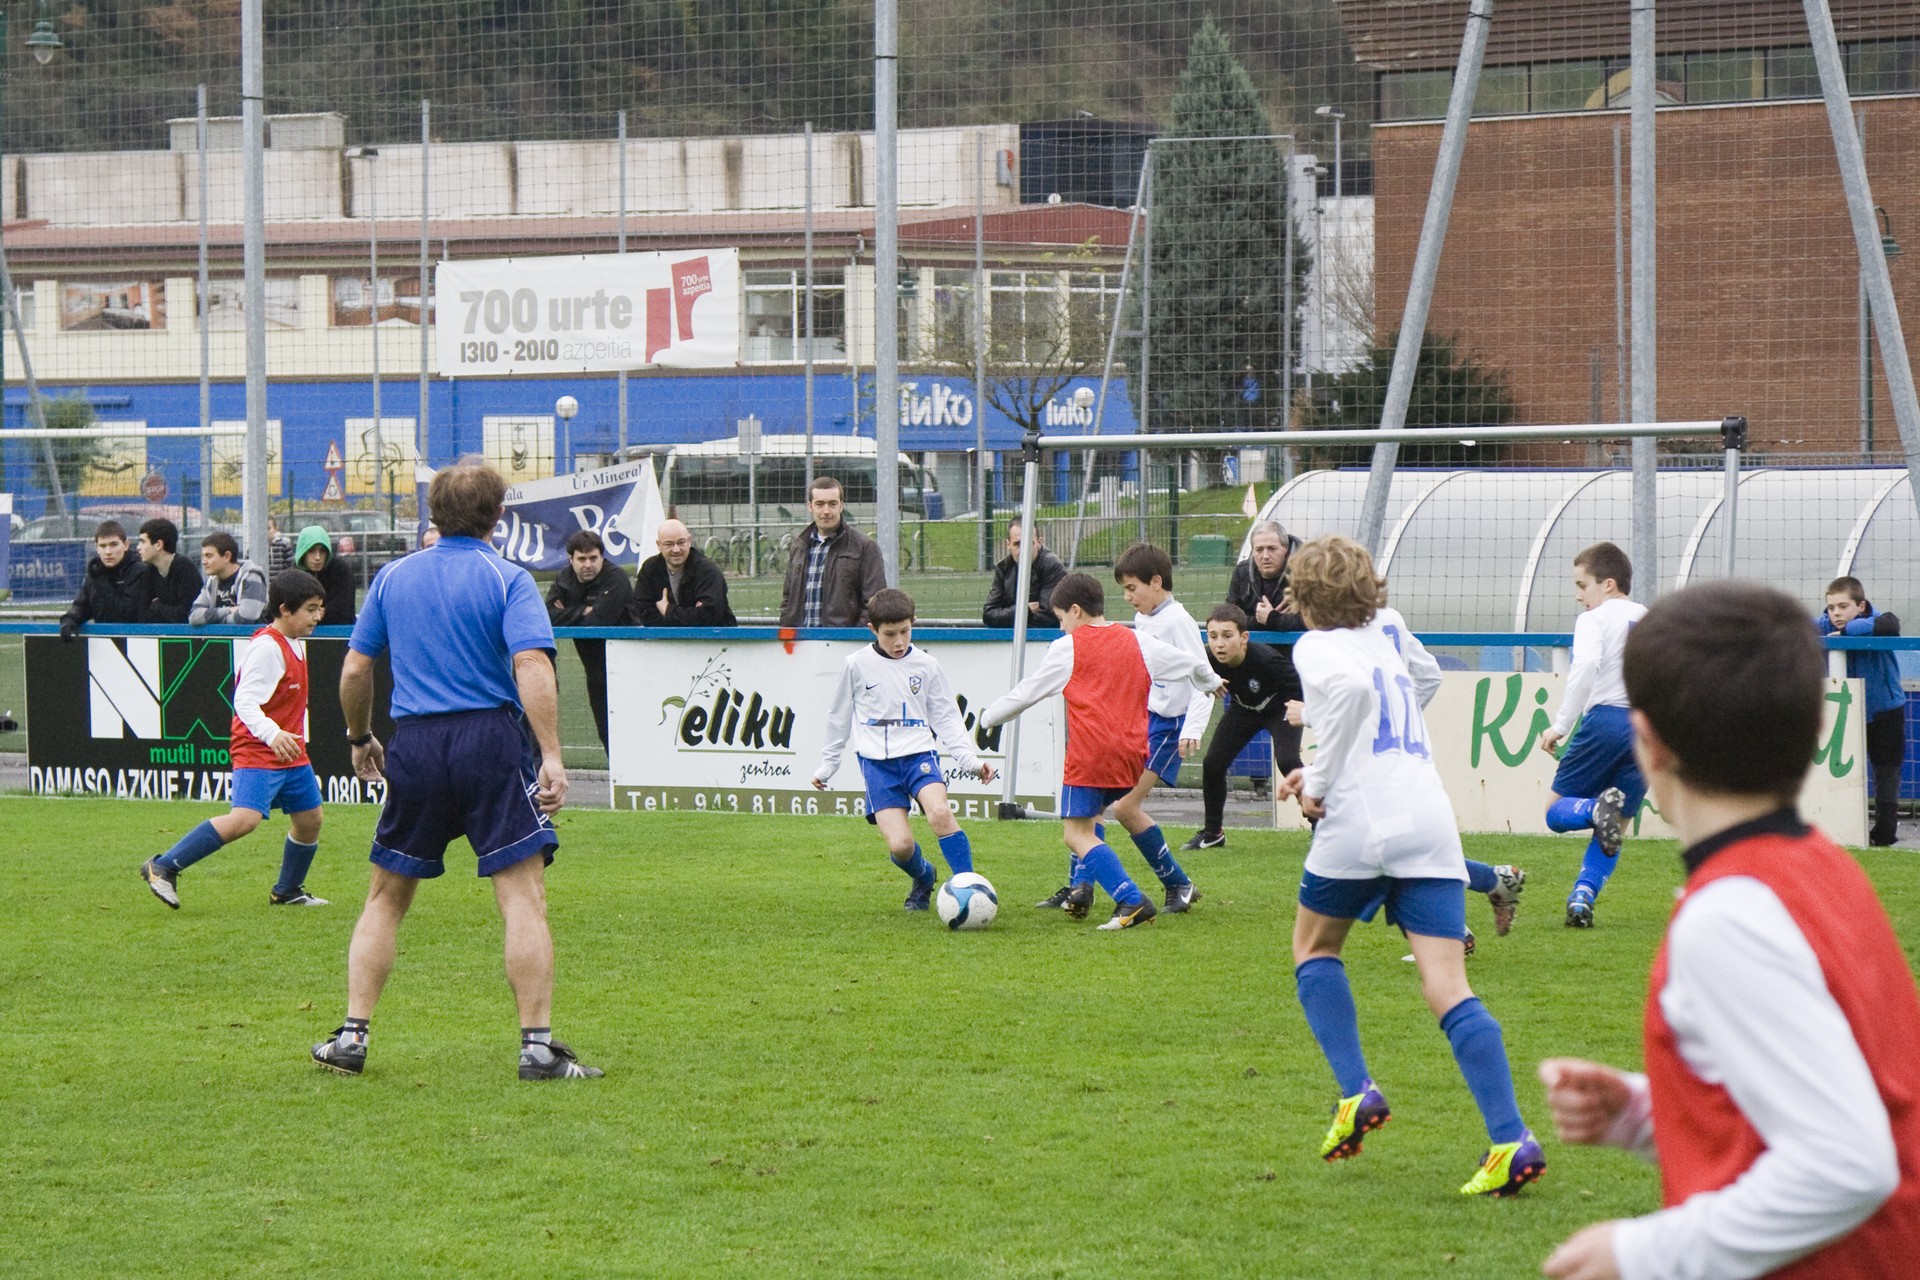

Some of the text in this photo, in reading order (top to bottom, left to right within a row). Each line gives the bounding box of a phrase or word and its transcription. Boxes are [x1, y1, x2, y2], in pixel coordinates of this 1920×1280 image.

[681, 273, 697, 288] 700
[460, 288, 632, 334] 700 urte
[461, 341, 498, 363] 1310
[514, 339, 559, 361] 2010
[562, 336, 632, 364] azpeitia
[593, 463, 642, 487] Mineral
[680, 687, 796, 750] eliku
[150, 744, 195, 764] mutil
[740, 759, 791, 784] zentroa
[752, 795, 776, 815] 81
[791, 796, 818, 816] 66
